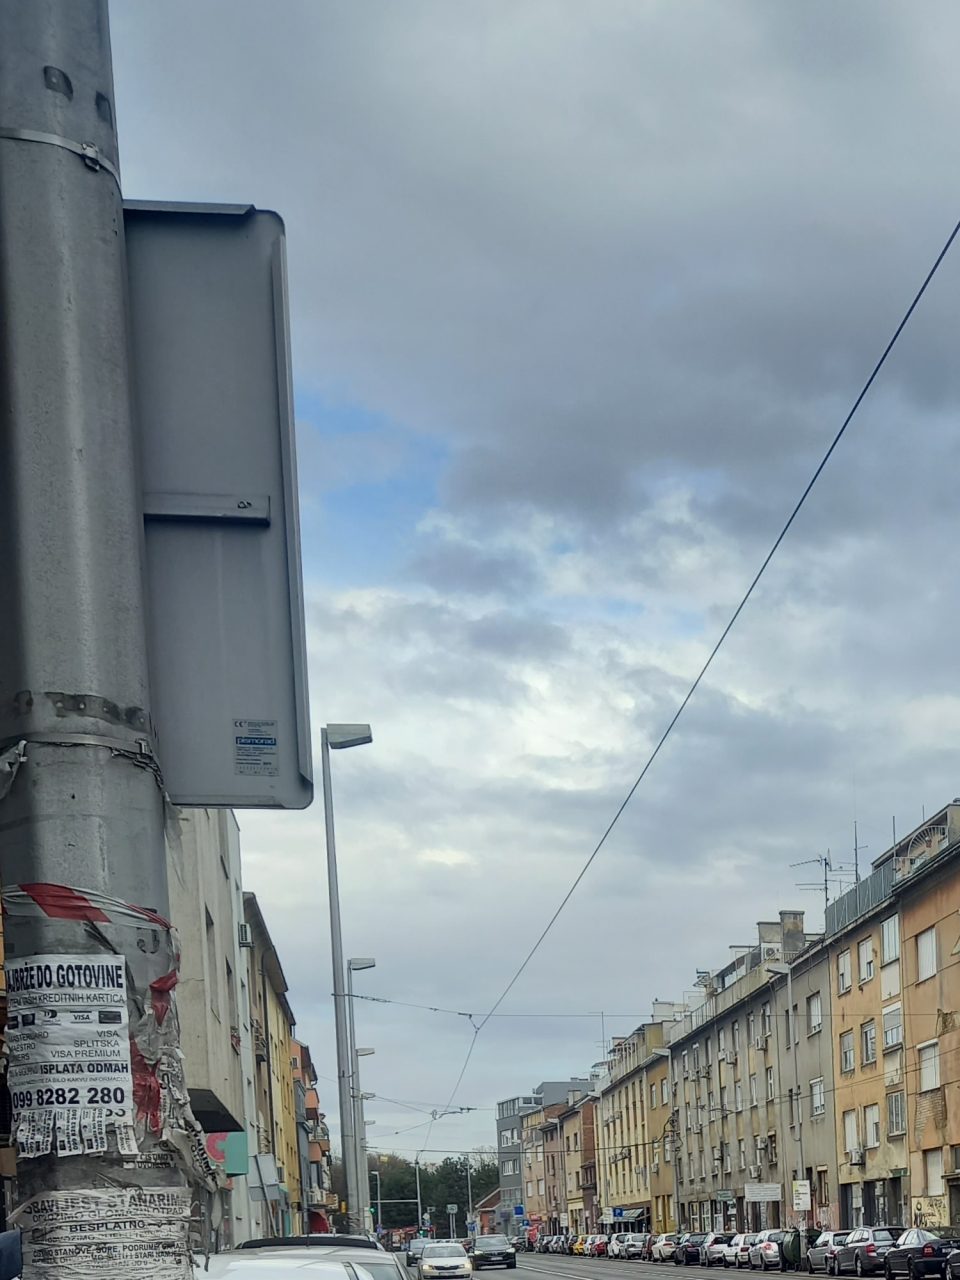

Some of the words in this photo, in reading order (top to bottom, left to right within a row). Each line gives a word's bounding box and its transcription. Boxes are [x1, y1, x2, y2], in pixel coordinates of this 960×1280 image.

[36, 965, 52, 988] DO
[57, 964, 123, 988] GOTOVINE
[38, 993, 84, 1003] KREDITNIH
[86, 993, 125, 1004] KARTICA
[73, 1013, 91, 1021] VISA
[97, 1030, 120, 1038] VISA
[73, 1040, 120, 1048] SPLITSKA
[51, 1050, 73, 1058] VISA
[75, 1050, 121, 1058] PREMIUM
[40, 1063, 84, 1075] ISPLATA
[87, 1063, 129, 1073] ODMAH
[13, 1091, 32, 1109] 099
[37, 1088, 80, 1105] 8282
[87, 1087, 125, 1105] 280
[69, 1220, 146, 1233] BESPLATNO
